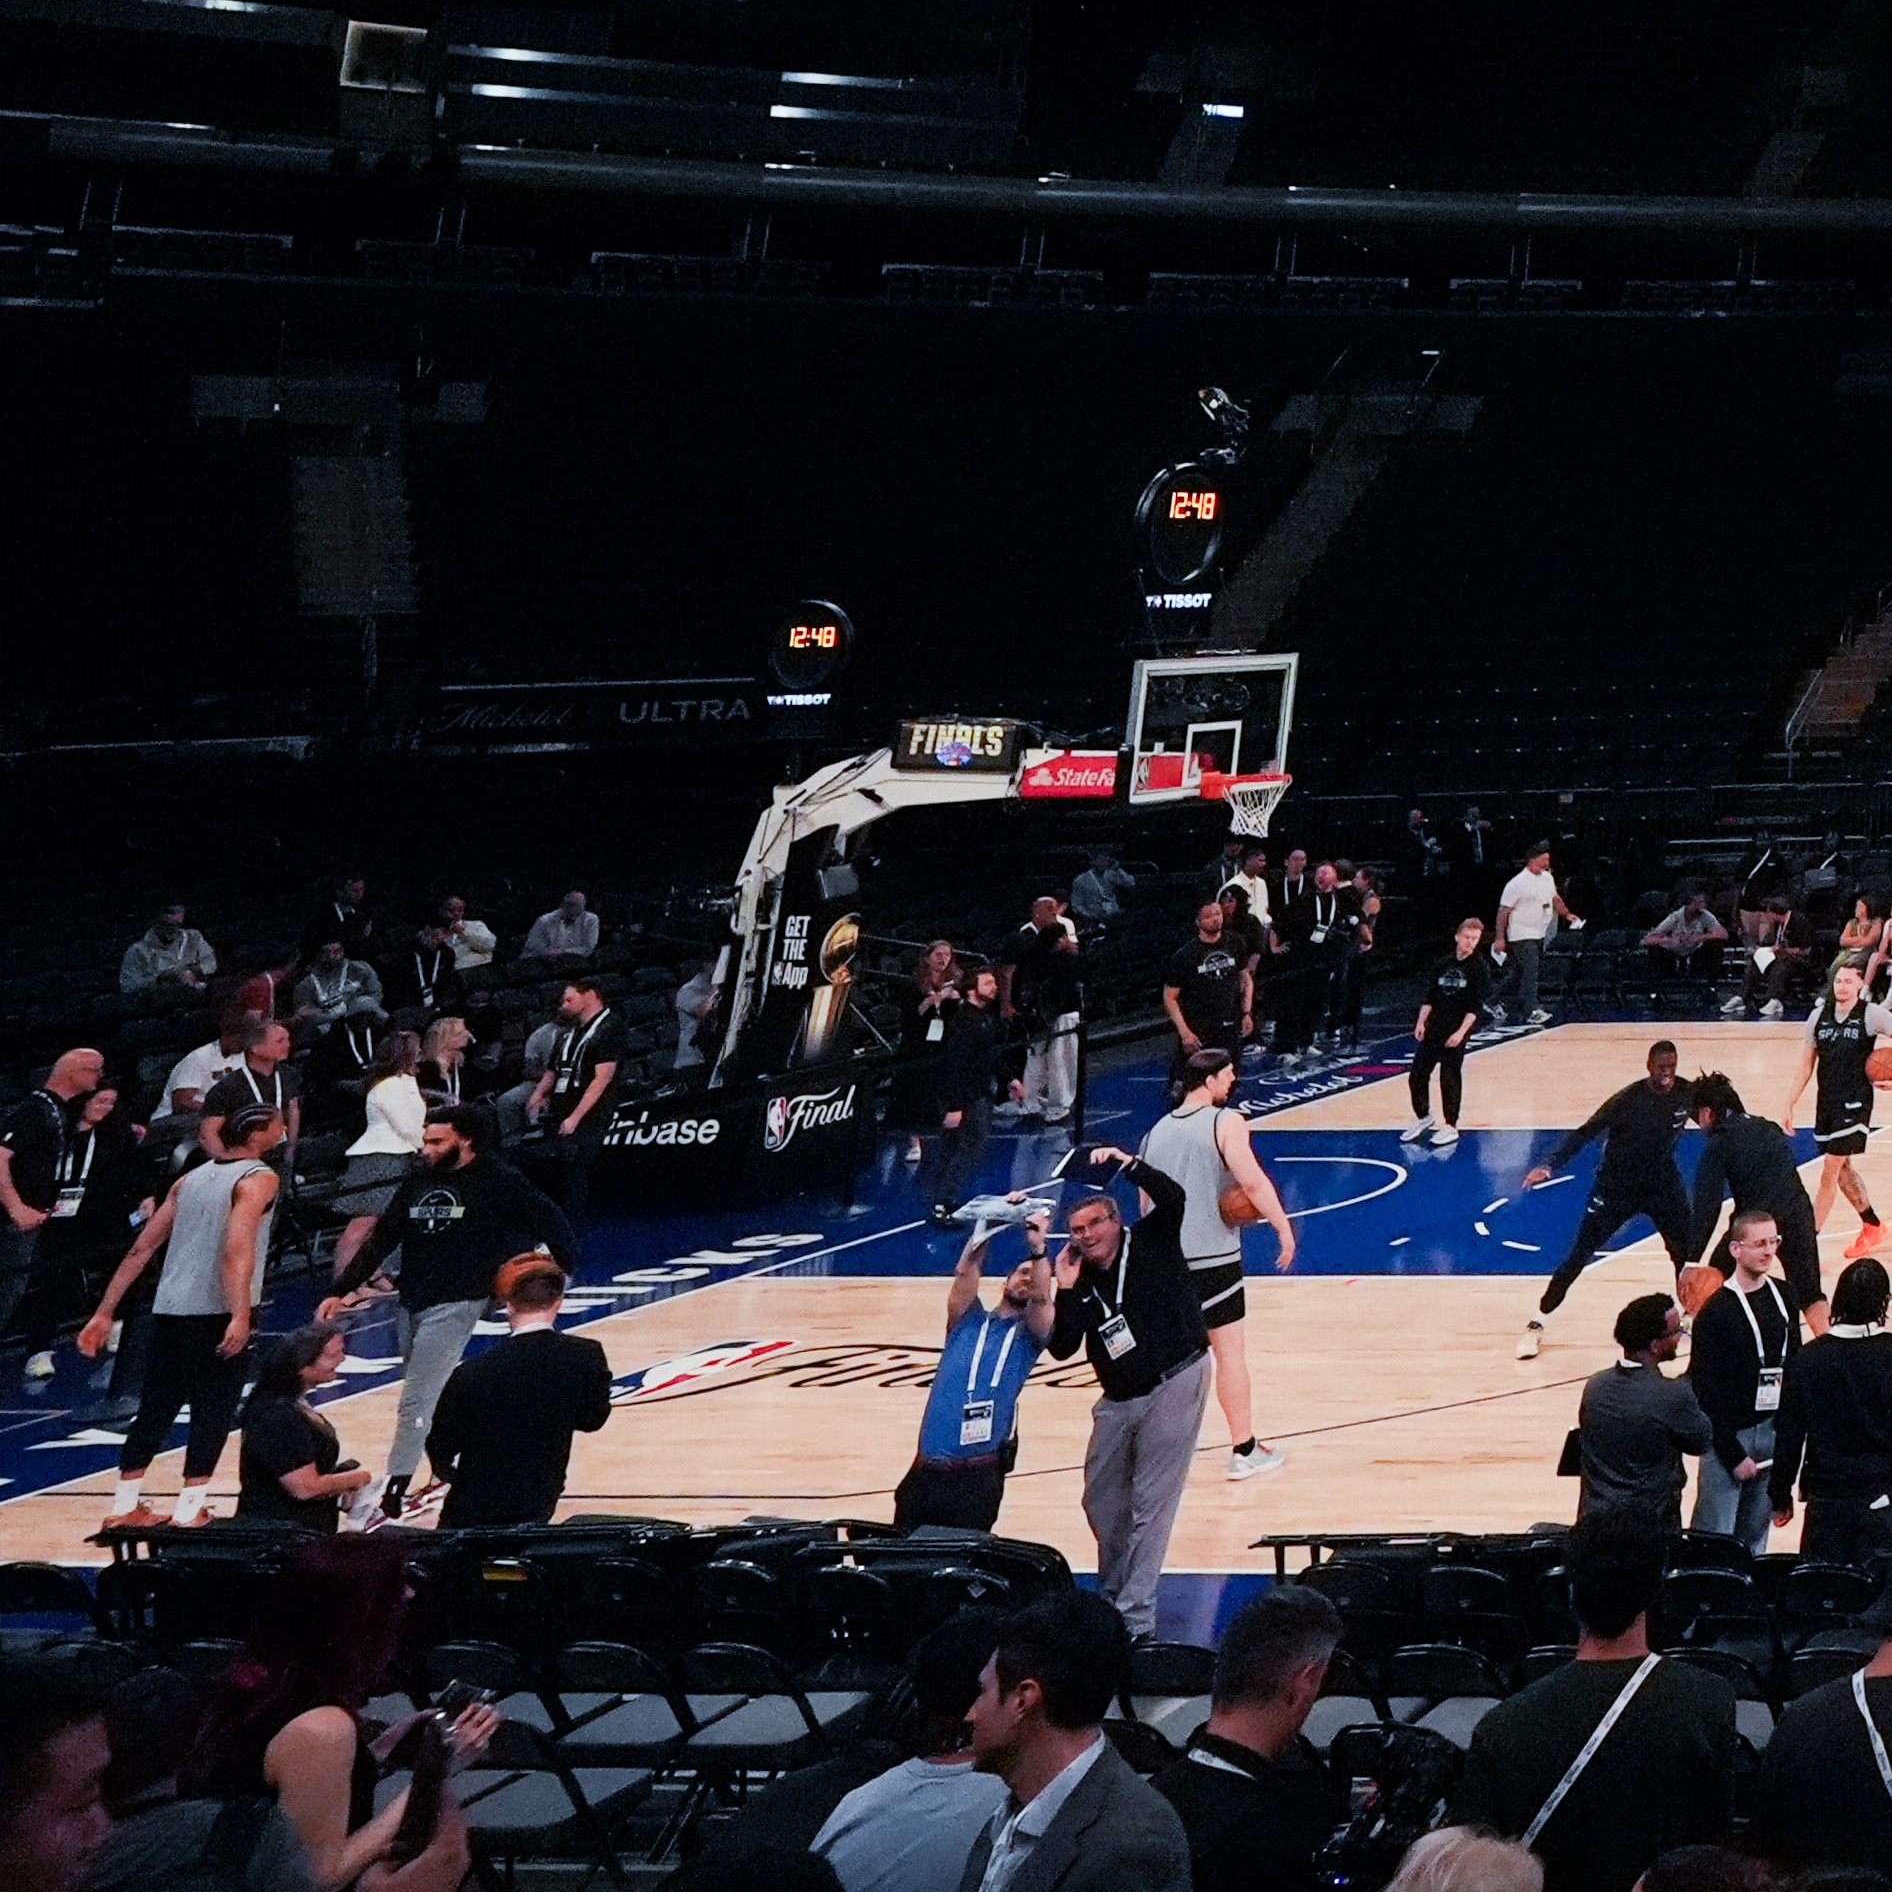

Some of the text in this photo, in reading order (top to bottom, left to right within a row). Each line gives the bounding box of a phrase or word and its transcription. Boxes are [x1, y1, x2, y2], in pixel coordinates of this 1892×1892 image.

[1169, 491, 1217, 520] 12:48
[1162, 593, 1212, 609] TISSOT
[789, 626, 837, 649] 12:48
[619, 697, 749, 725] ULTRA
[784, 693, 832, 706] TISSOT
[908, 723, 1004, 757] FINALS
[1053, 767, 1116, 790] StateFa
[784, 915, 811, 938] GET
[783, 938, 806, 961] THE
[781, 965, 809, 990] App
[602, 1110, 721, 1146] inbase
[771, 1084, 856, 1153] Final
